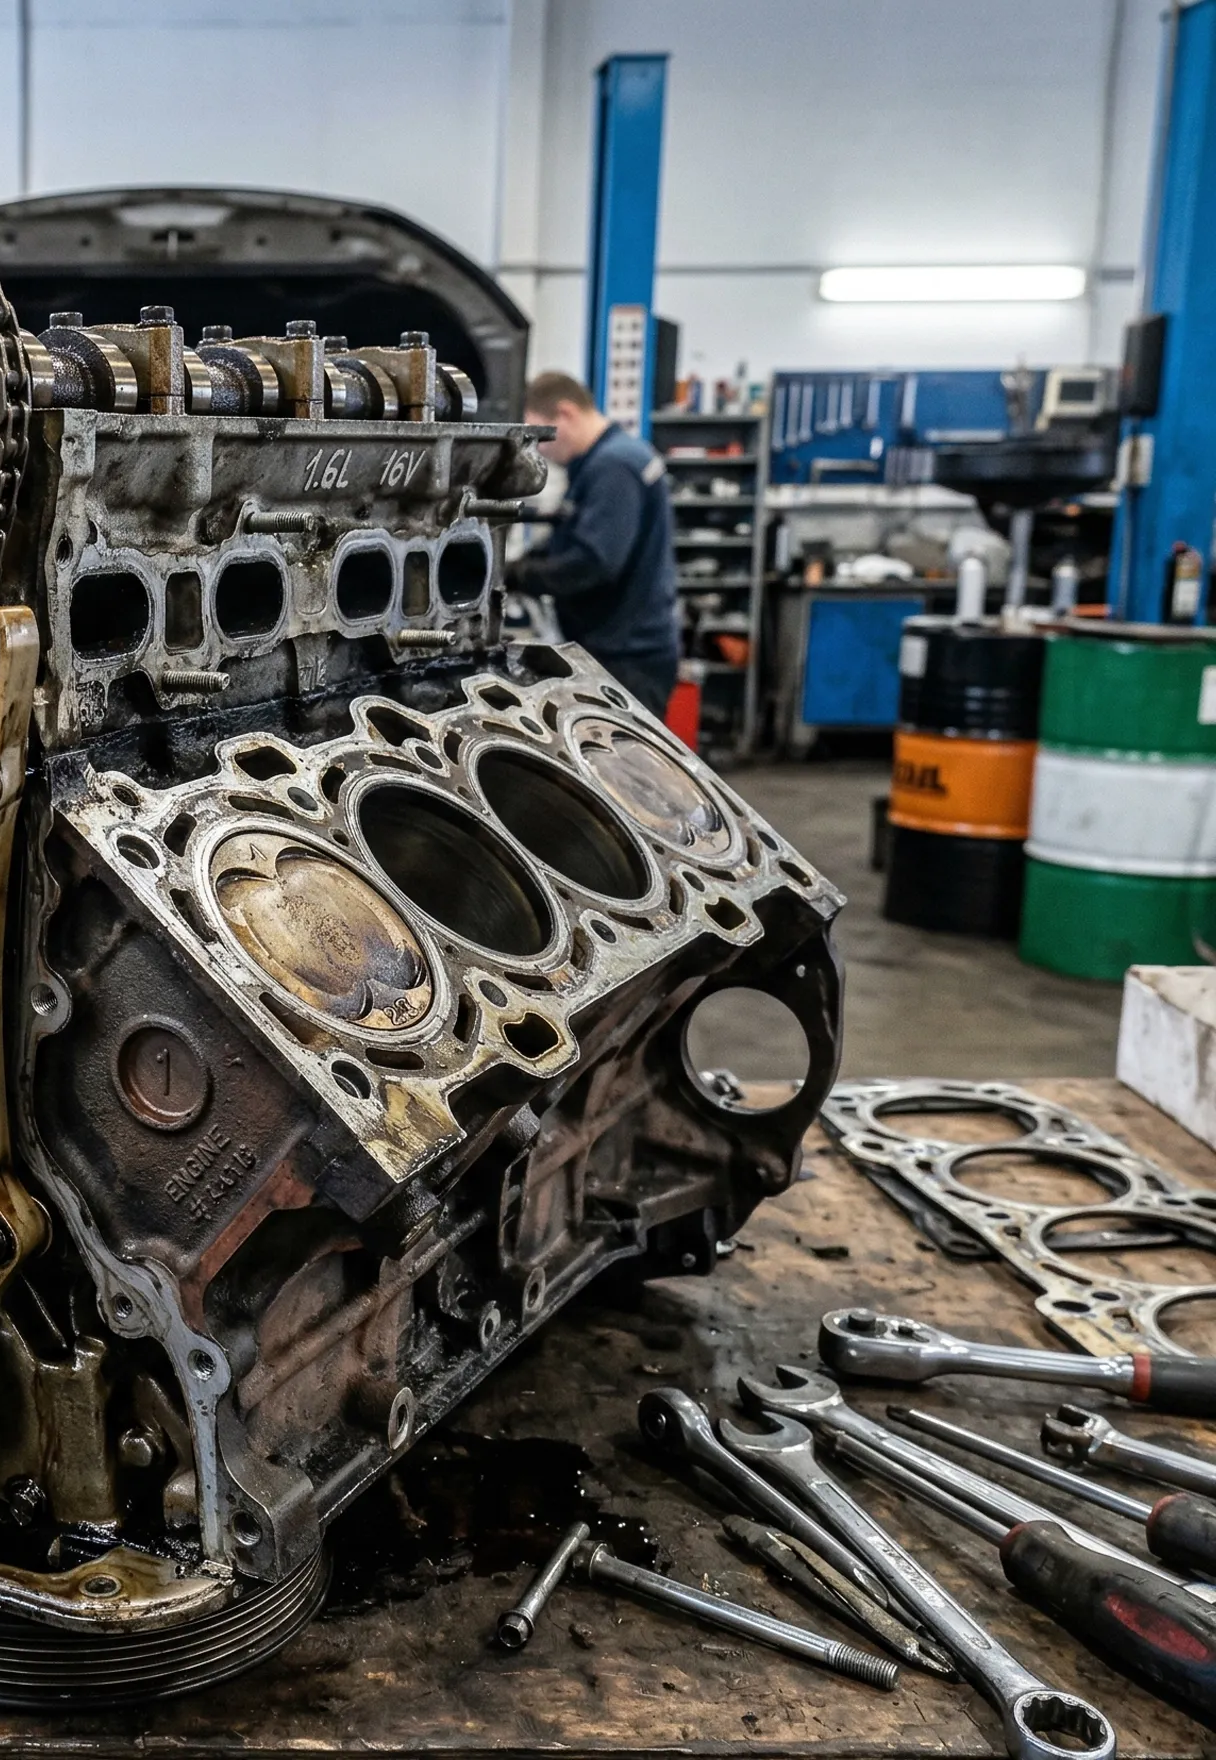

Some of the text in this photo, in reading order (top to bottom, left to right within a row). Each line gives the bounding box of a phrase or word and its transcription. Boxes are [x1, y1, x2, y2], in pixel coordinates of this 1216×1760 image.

[304, 448, 426, 492] 1.6L 16V
[164, 1123, 232, 1203] ENGINE
